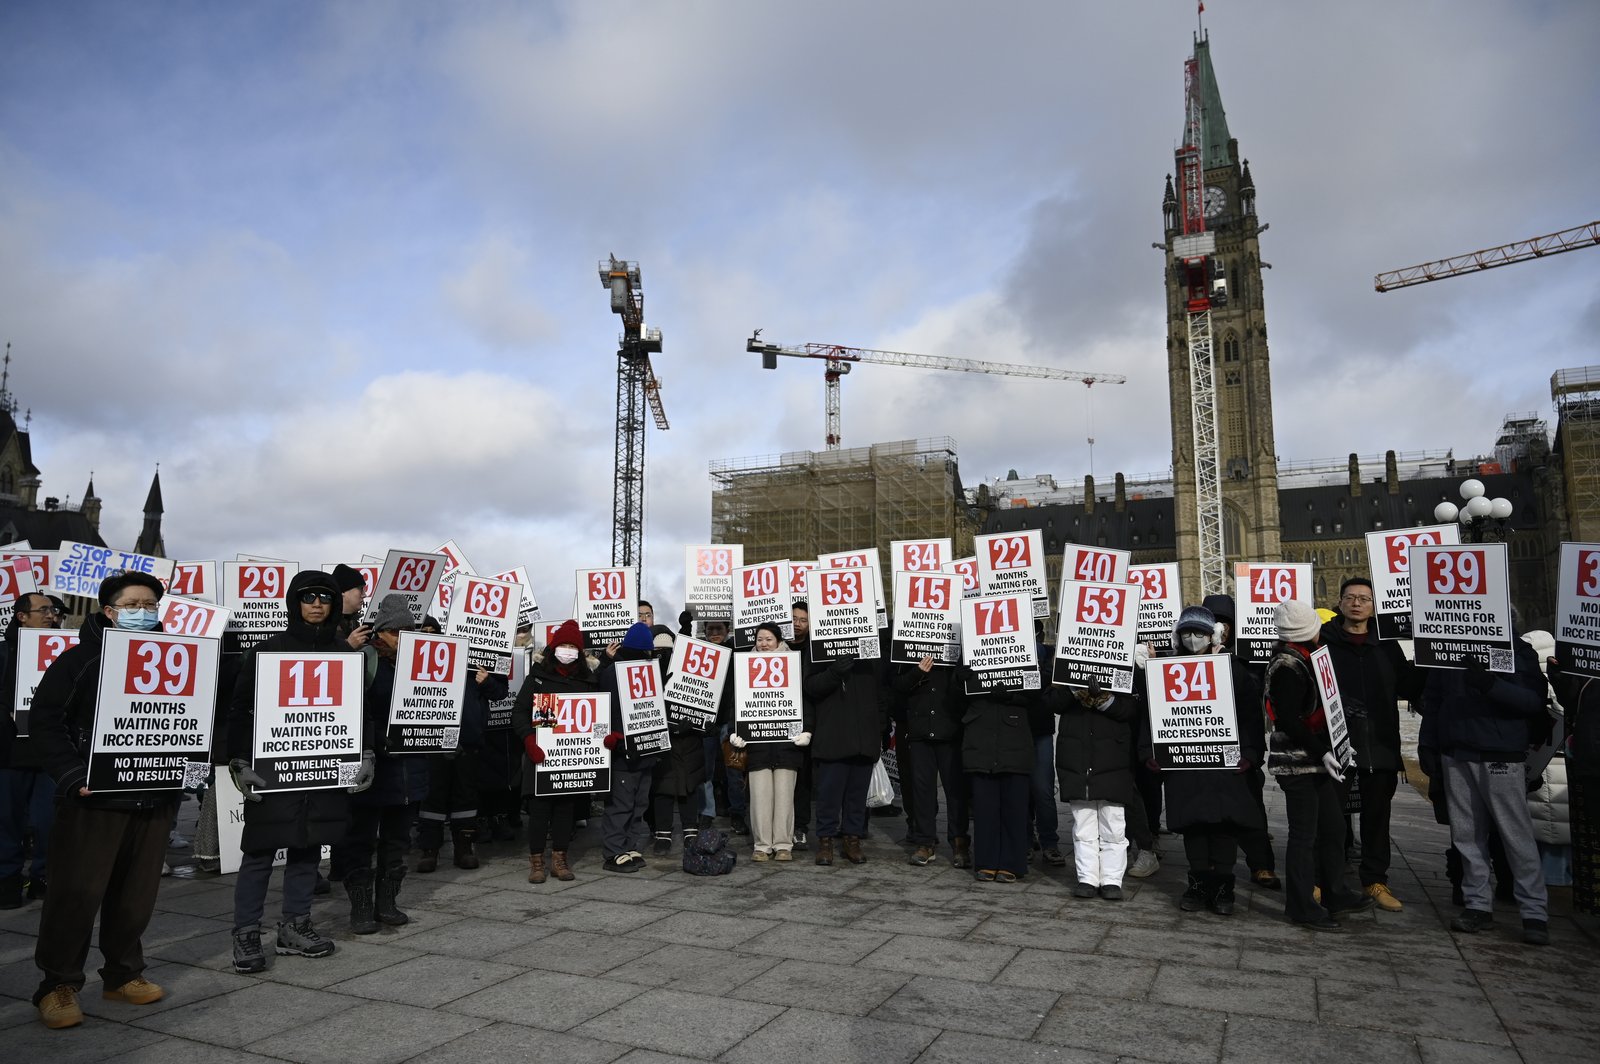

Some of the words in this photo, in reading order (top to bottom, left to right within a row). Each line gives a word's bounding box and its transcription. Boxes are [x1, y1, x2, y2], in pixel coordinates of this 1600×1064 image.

[69, 544, 112, 564] STOP
[119, 552, 155, 572] THE
[907, 544, 936, 570] 34
[994, 538, 1026, 569] 22
[701, 550, 728, 575] 38
[1079, 552, 1111, 582] 40
[396, 559, 430, 590] 68
[996, 571, 1028, 580] MONTHS
[1434, 552, 1479, 593] 39
[171, 567, 198, 594] 27
[244, 568, 279, 598] 29
[747, 568, 774, 596] 40
[989, 580, 1020, 590] WAITING
[1022, 579, 1037, 587] FOR
[1130, 570, 1162, 599] 33
[1255, 570, 1292, 602] 46
[593, 573, 621, 600] 30
[827, 573, 858, 604] 53
[914, 578, 944, 609] 15
[470, 583, 504, 617] 68
[748, 597, 775, 607] MONTHS
[1382, 601, 1404, 609] IRCC
[1436, 600, 1481, 610] MONTHS
[243, 602, 279, 610] MONTHS
[741, 607, 768, 616] WAITING
[1082, 588, 1120, 624] 53
[827, 608, 859, 617] MONTHS
[912, 612, 944, 620] MONTHS
[980, 600, 1013, 633] 71
[1425, 612, 1470, 622] WAITING
[1473, 613, 1495, 623] FOR
[166, 604, 208, 636] 30
[466, 617, 499, 628] MONTHS
[738, 616, 752, 625] IRCC
[753, 612, 787, 623] RESPONSE
[819, 618, 851, 627] WAITING
[833, 626, 873, 635] RESPONSE
[903, 621, 938, 629] WAITING
[937, 622, 952, 630] FOR
[1242, 627, 1260, 635] IRCC
[1420, 624, 1442, 633] IRCC
[1444, 625, 1503, 636] RESPONSE
[457, 625, 489, 636] WAITING
[491, 630, 506, 639] FOR
[916, 630, 956, 640] RESPONSE
[1078, 627, 1115, 638] MONTHS
[1562, 627, 1586, 639] IRCC
[981, 636, 1015, 646] MONTHS
[1068, 637, 1104, 648] WAITING
[1106, 641, 1124, 650] FOR
[1431, 642, 1442, 650] NO
[973, 646, 1007, 657] WAITING
[1009, 645, 1025, 654] FOR
[1062, 647, 1080, 656] IRCC
[1081, 648, 1128, 661] RESPONSE
[1572, 648, 1584, 656] NO
[417, 642, 450, 681] 19
[687, 645, 716, 676] 55
[969, 659, 986, 668] IRCC
[988, 654, 1031, 666] RESPONSE
[1575, 660, 1587, 668] NO
[133, 642, 190, 695] 39
[753, 657, 784, 687] 28
[978, 672, 987, 680] NO
[1169, 663, 1211, 700] 34
[288, 661, 333, 705] 11
[631, 666, 653, 698] 51
[682, 676, 709, 688] MONTHS
[982, 680, 991, 688] NO
[413, 686, 447, 696] MONTHS
[673, 683, 700, 695] WAITING
[701, 690, 713, 699] FOR
[403, 698, 436, 708] WAITING
[439, 699, 454, 708] FOR
[667, 690, 681, 700] IRCC
[682, 693, 715, 708] RESPONSE
[130, 702, 186, 714] MONTHS
[634, 701, 654, 710] MONTHS
[1171, 706, 1212, 715] MONTHS
[285, 712, 335, 723] MONTHS
[396, 710, 414, 720] IRCC
[416, 711, 457, 720] RESPONSE
[557, 700, 592, 732] 40
[629, 710, 650, 720] WAITING
[679, 706, 706, 718] TIMELINES
[114, 718, 169, 730] WAITING
[173, 718, 198, 730] FOR
[628, 722, 639, 731] IRCC
[639, 718, 664, 729] RESPONSE
[1162, 718, 1202, 727] WAITING
[1205, 717, 1224, 725] FOR
[271, 726, 321, 737] WAITING
[325, 725, 348, 735] FOR
[402, 728, 412, 736] NO
[1158, 730, 1178, 738] IRCC
[1180, 728, 1231, 738] RESPONSE
[103, 734, 133, 746] IRCC
[136, 734, 204, 746] RESPONSE
[404, 738, 413, 746] NO
[415, 738, 443, 746] RESULTS
[557, 738, 591, 746] MONTHS
[641, 732, 661, 742] TIMELINES
[263, 741, 289, 752] IRCC
[292, 738, 354, 751] RESPONSE
[644, 741, 661, 750] RESULTS
[1181, 745, 1222, 753] TIMELINES
[547, 748, 582, 757] WAITING
[585, 747, 600, 755] FOR
[115, 758, 131, 768] NO
[562, 757, 605, 766] RESPONSE
[1186, 755, 1220, 763] RESULTS
[275, 761, 289, 771] NO
[118, 771, 133, 781] NO
[136, 770, 183, 781] RESULTS
[279, 773, 292, 782] NO
[296, 771, 338, 781] RESULTS
[561, 772, 596, 780] TIMELINES
[564, 780, 593, 788] RESULTS
